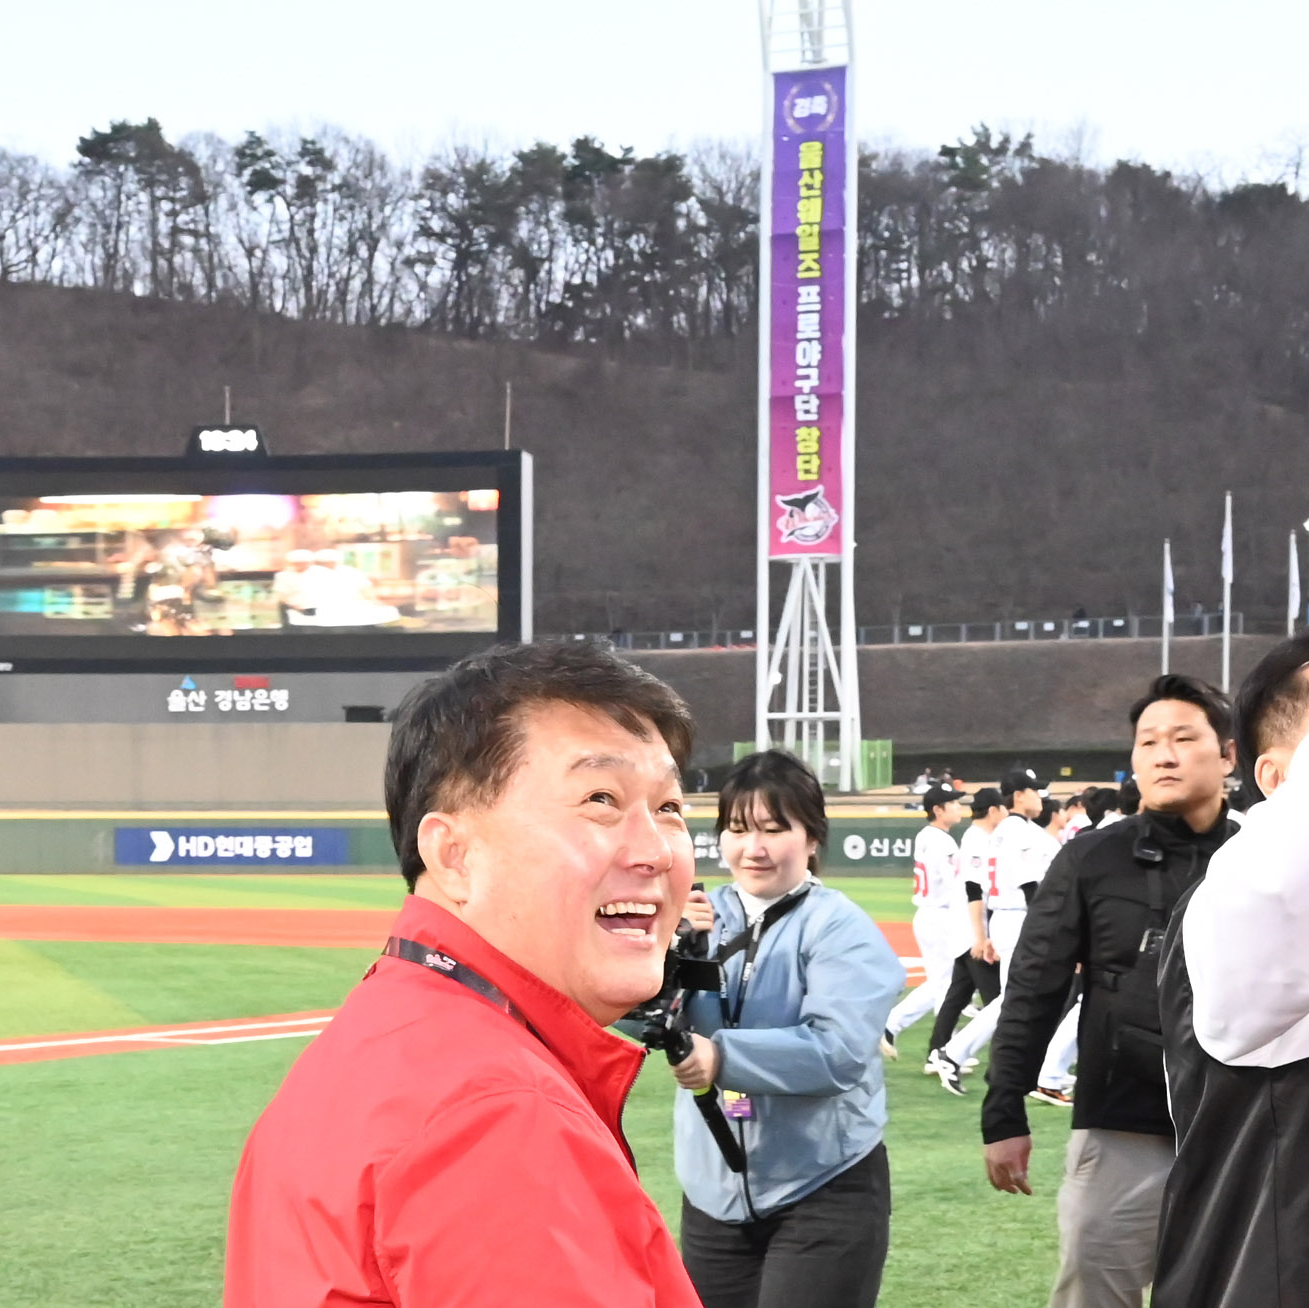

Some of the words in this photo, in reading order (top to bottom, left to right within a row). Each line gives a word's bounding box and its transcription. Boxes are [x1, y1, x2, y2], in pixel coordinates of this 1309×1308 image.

[794, 285, 822, 422] 프로야구단
[795, 426, 821, 481] 창단
[167, 689, 207, 712] 울산
[214, 689, 289, 712] 경남은행
[178, 835, 313, 858] HD현대중공업
